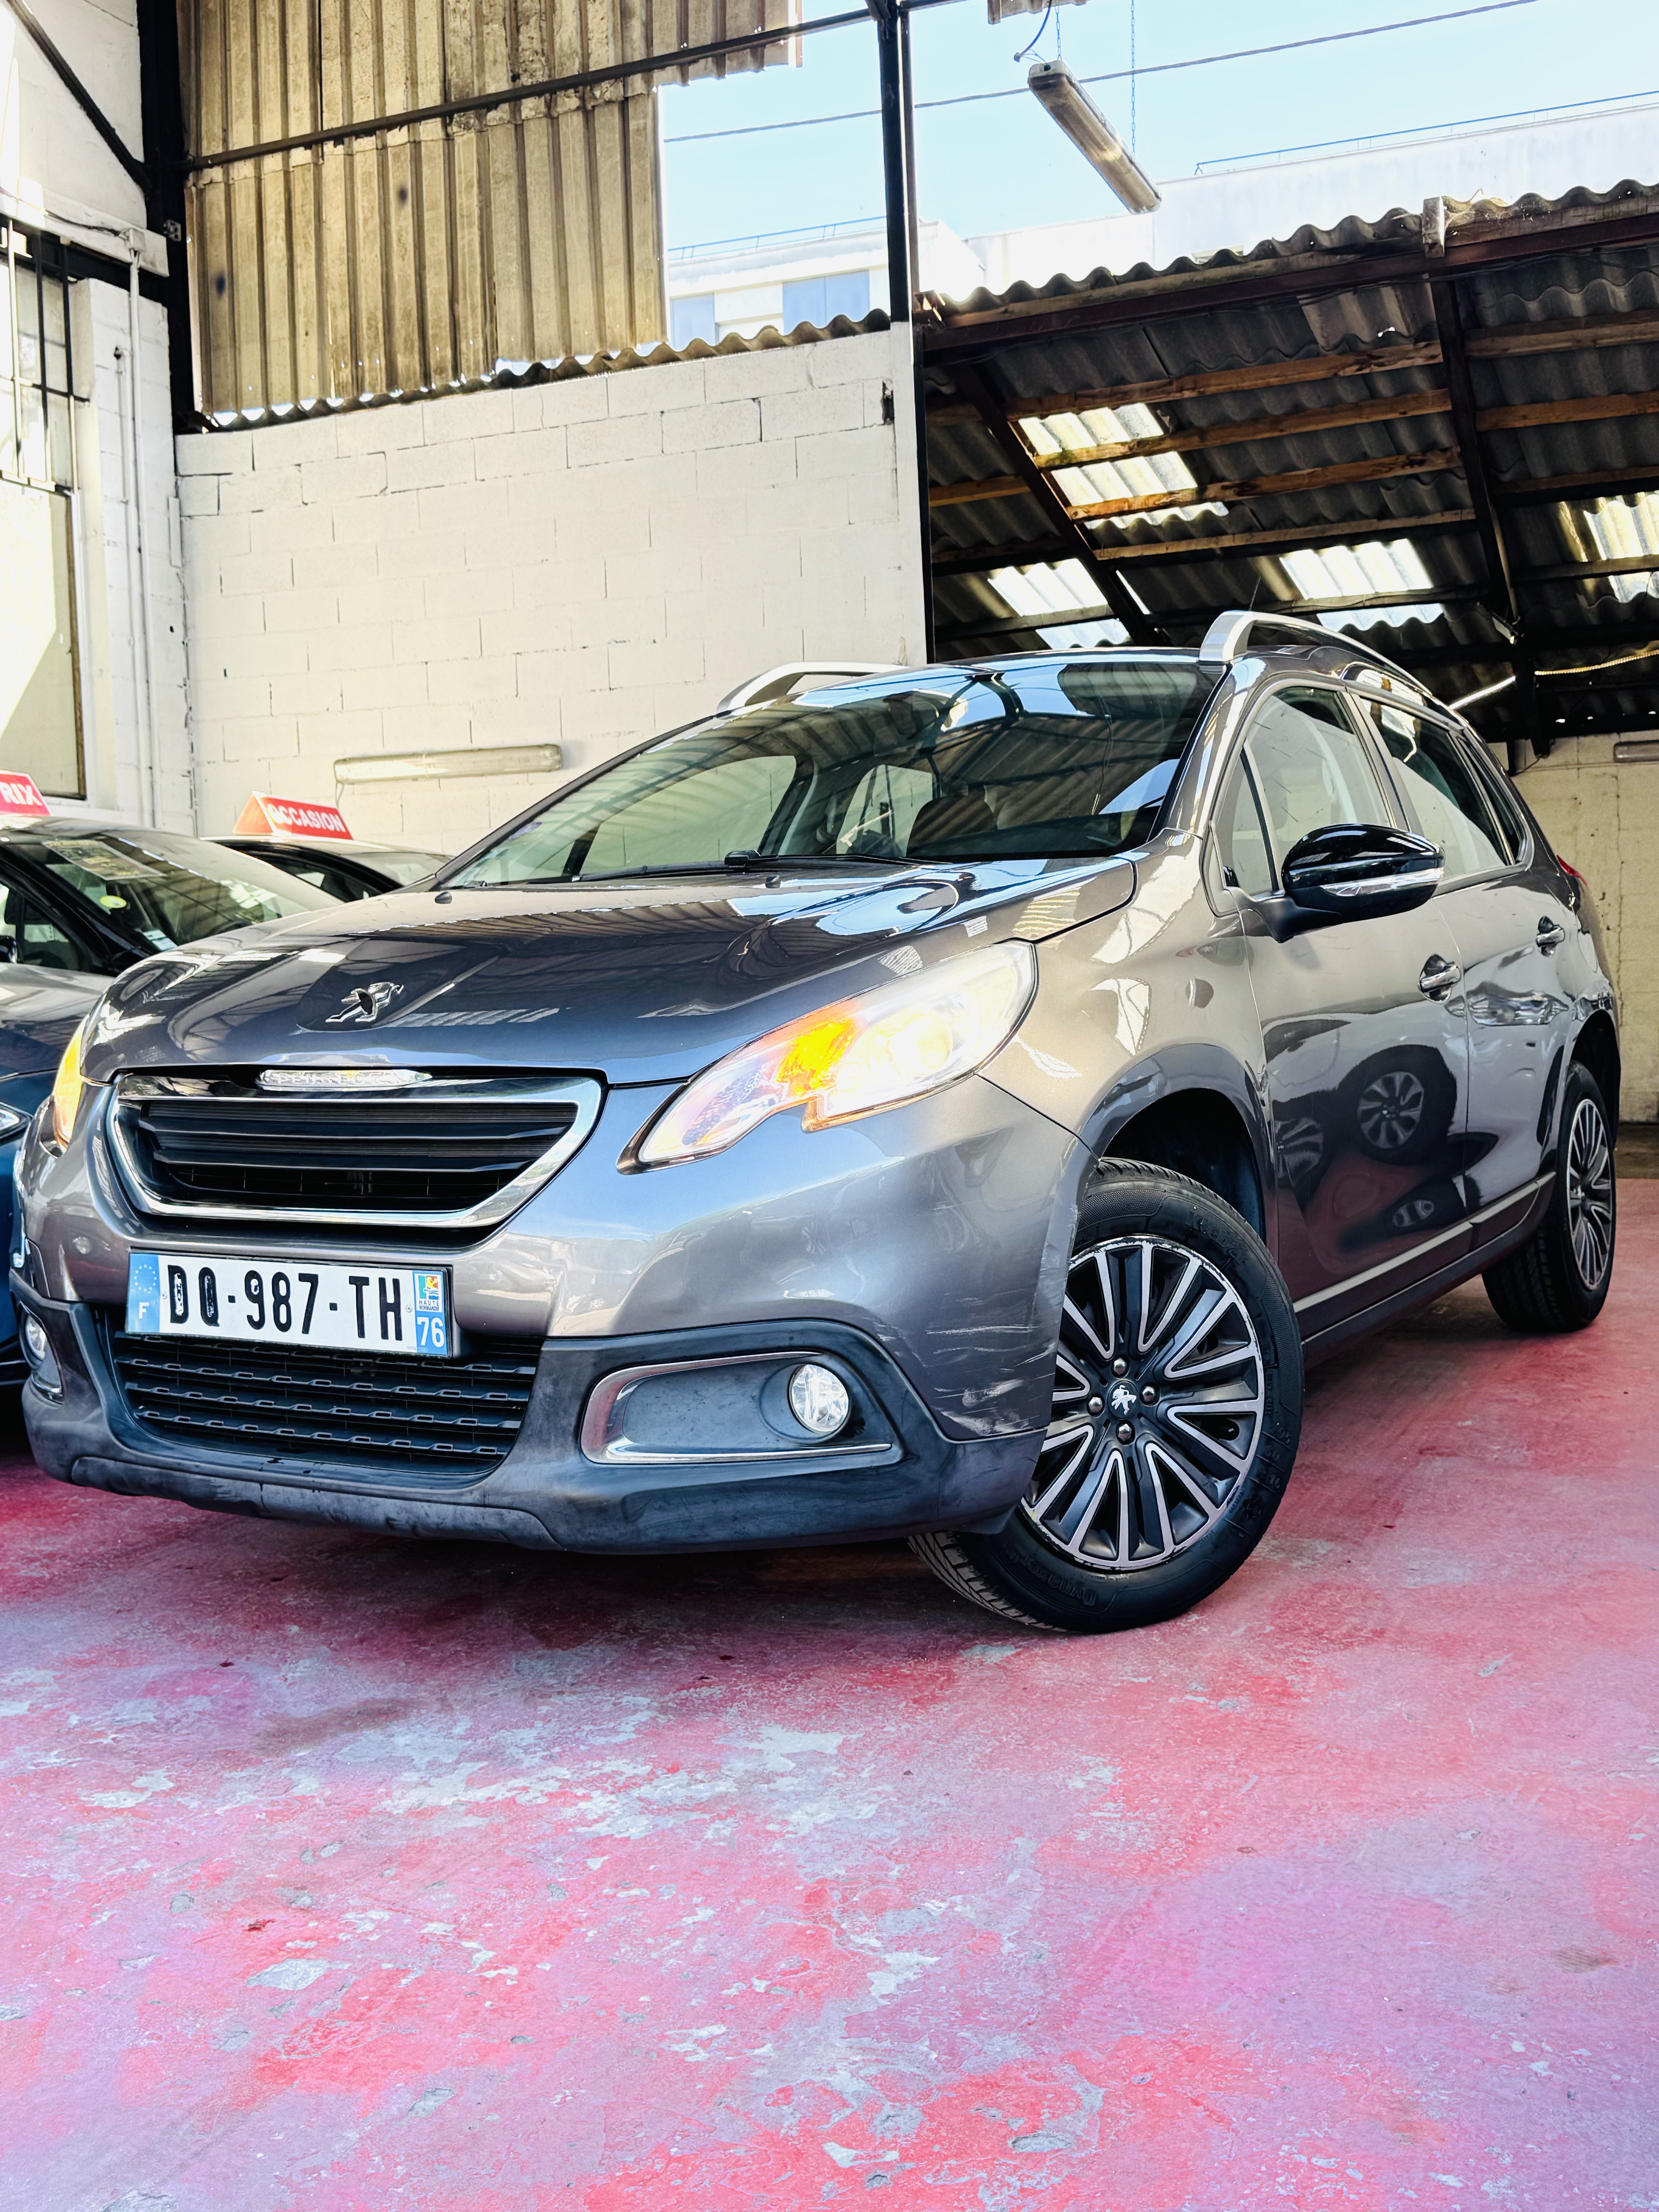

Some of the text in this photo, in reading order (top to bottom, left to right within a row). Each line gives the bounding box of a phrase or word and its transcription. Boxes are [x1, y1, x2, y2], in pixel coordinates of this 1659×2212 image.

[267, 802, 346, 833] OCCASION
[277, 1072, 382, 1084] PEUGEOT
[139, 1302, 149, 1319] F
[417, 1317, 445, 1348] 76
